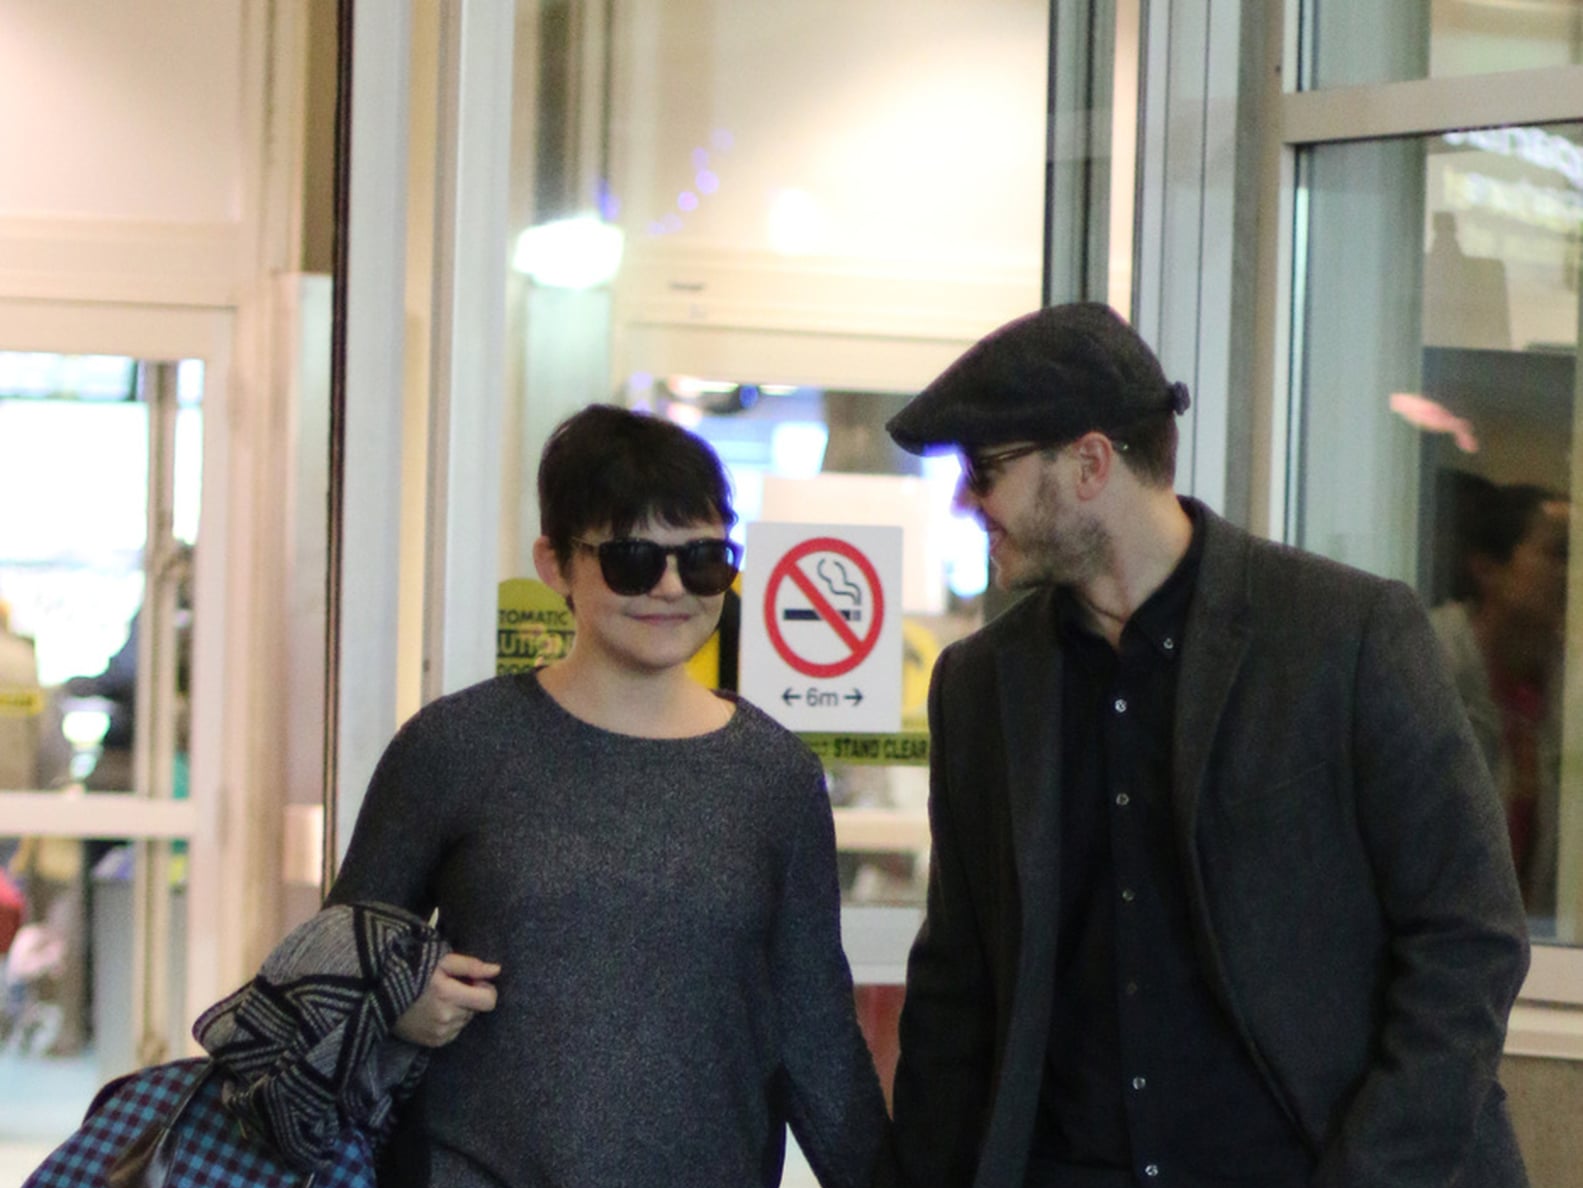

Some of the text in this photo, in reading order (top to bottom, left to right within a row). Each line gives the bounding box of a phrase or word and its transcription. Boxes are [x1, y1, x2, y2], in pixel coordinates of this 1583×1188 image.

[806, 687, 839, 707] 6m
[834, 737, 879, 759] STAND
[883, 738, 929, 760] CLEAR
